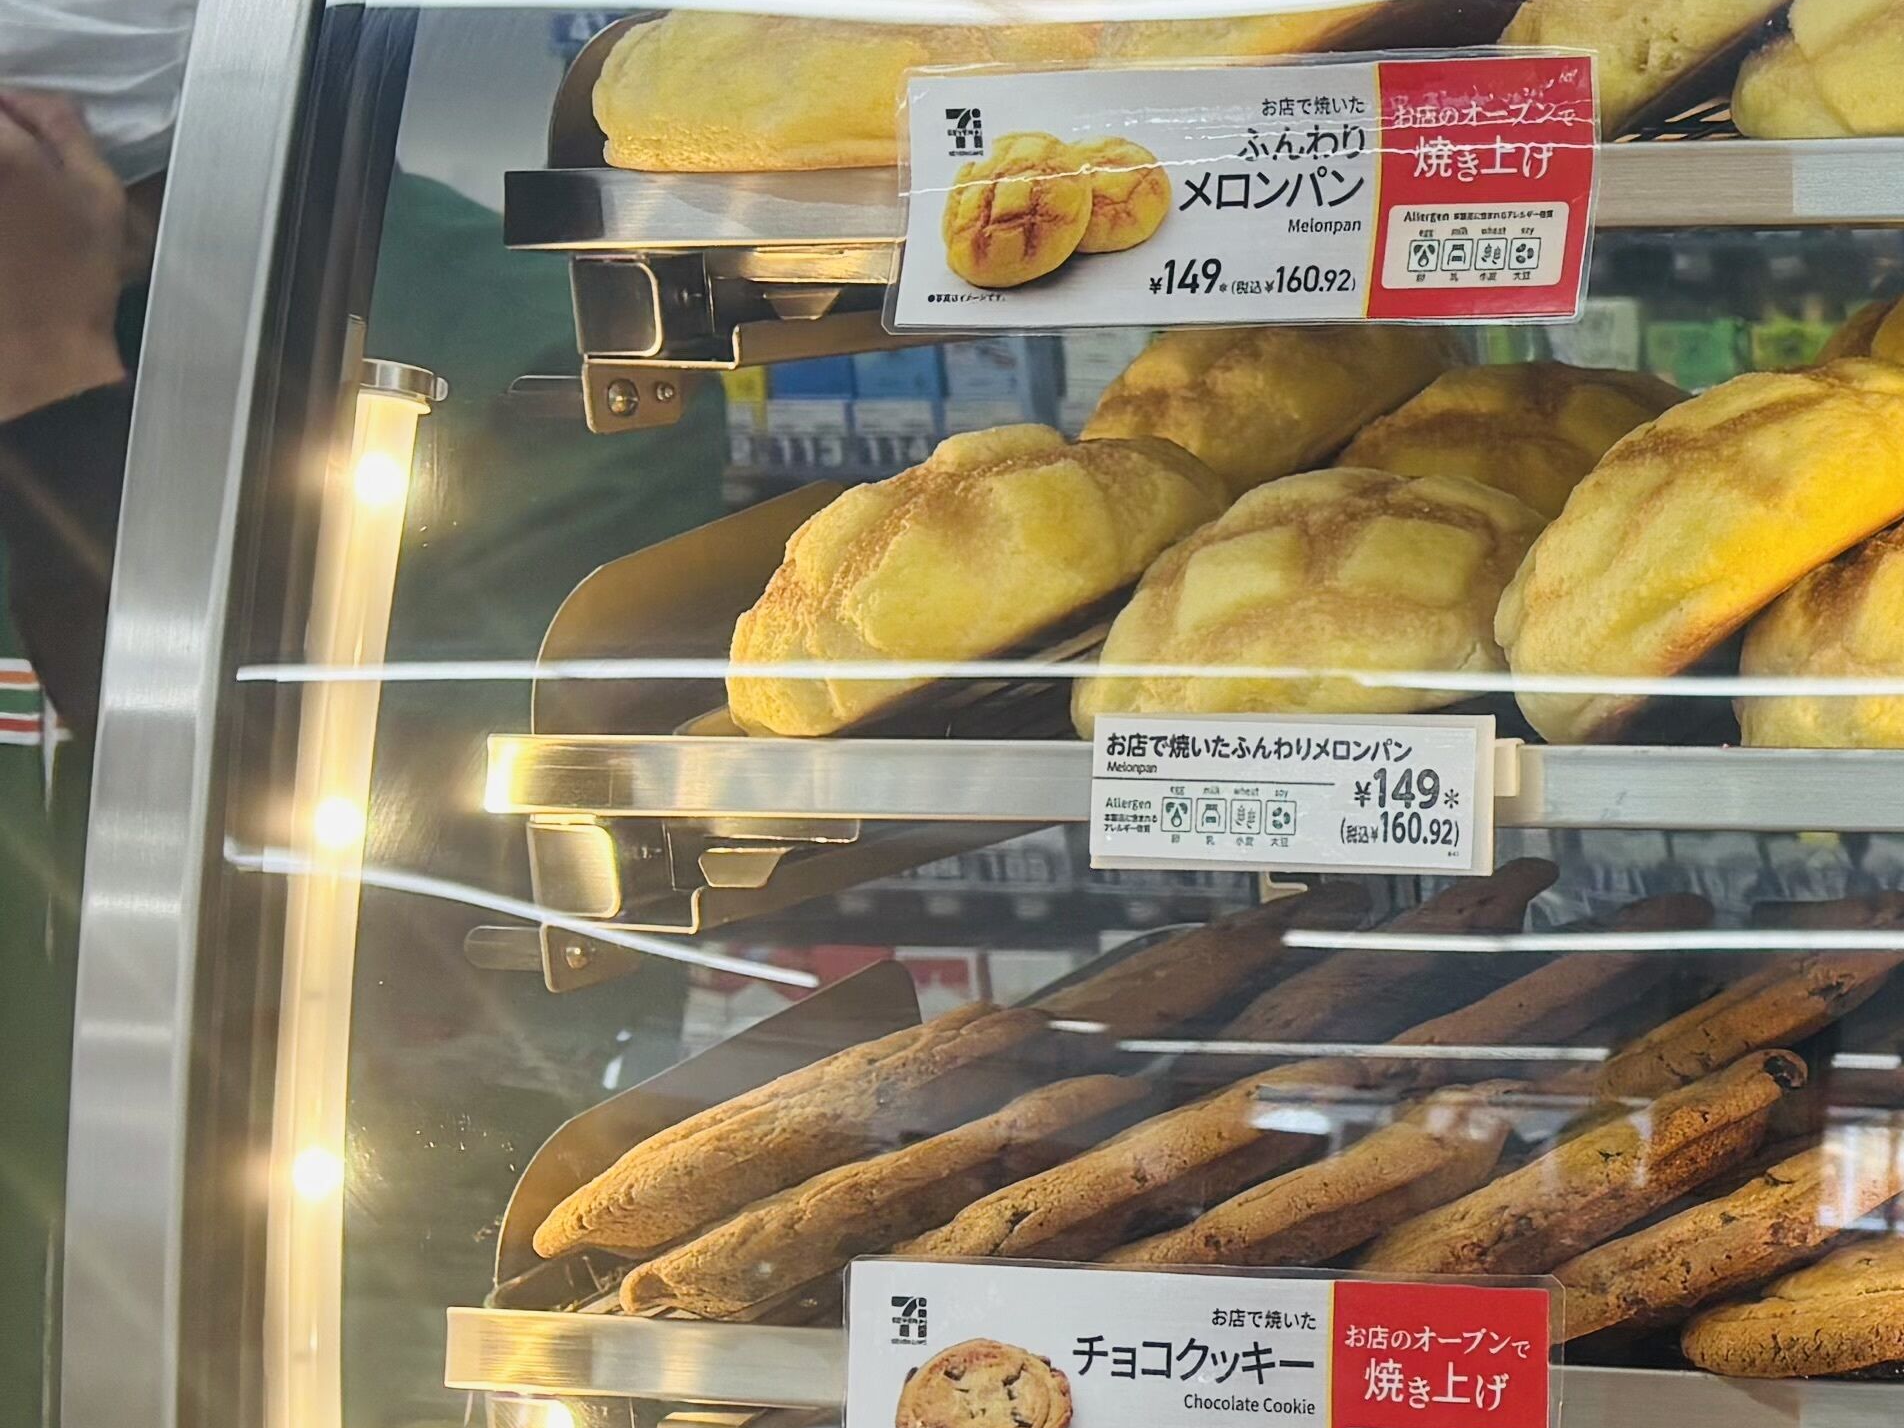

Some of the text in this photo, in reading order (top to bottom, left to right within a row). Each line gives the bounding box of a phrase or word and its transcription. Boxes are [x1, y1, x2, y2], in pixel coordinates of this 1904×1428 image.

[1262, 96, 1366, 117] お店で焼いた
[1238, 123, 1366, 161] ふんわり
[1413, 135, 1554, 182] 焼き上げ
[1179, 165, 1365, 212] メロンパン
[1288, 217, 1362, 236] Melonpan
[1106, 732, 1413, 763] お店で焼いたふんわりメロンパン
[1106, 760, 1158, 775] Melonpan
[1211, 1308, 1317, 1331] お店で焼いた
[1344, 1325, 1531, 1360] お店のオーブンで
[1072, 1335, 1315, 1386] チョコクッキー
[1363, 1360, 1508, 1411] 焼き上げ
[1183, 1393, 1316, 1415] Chocolate Cookie
